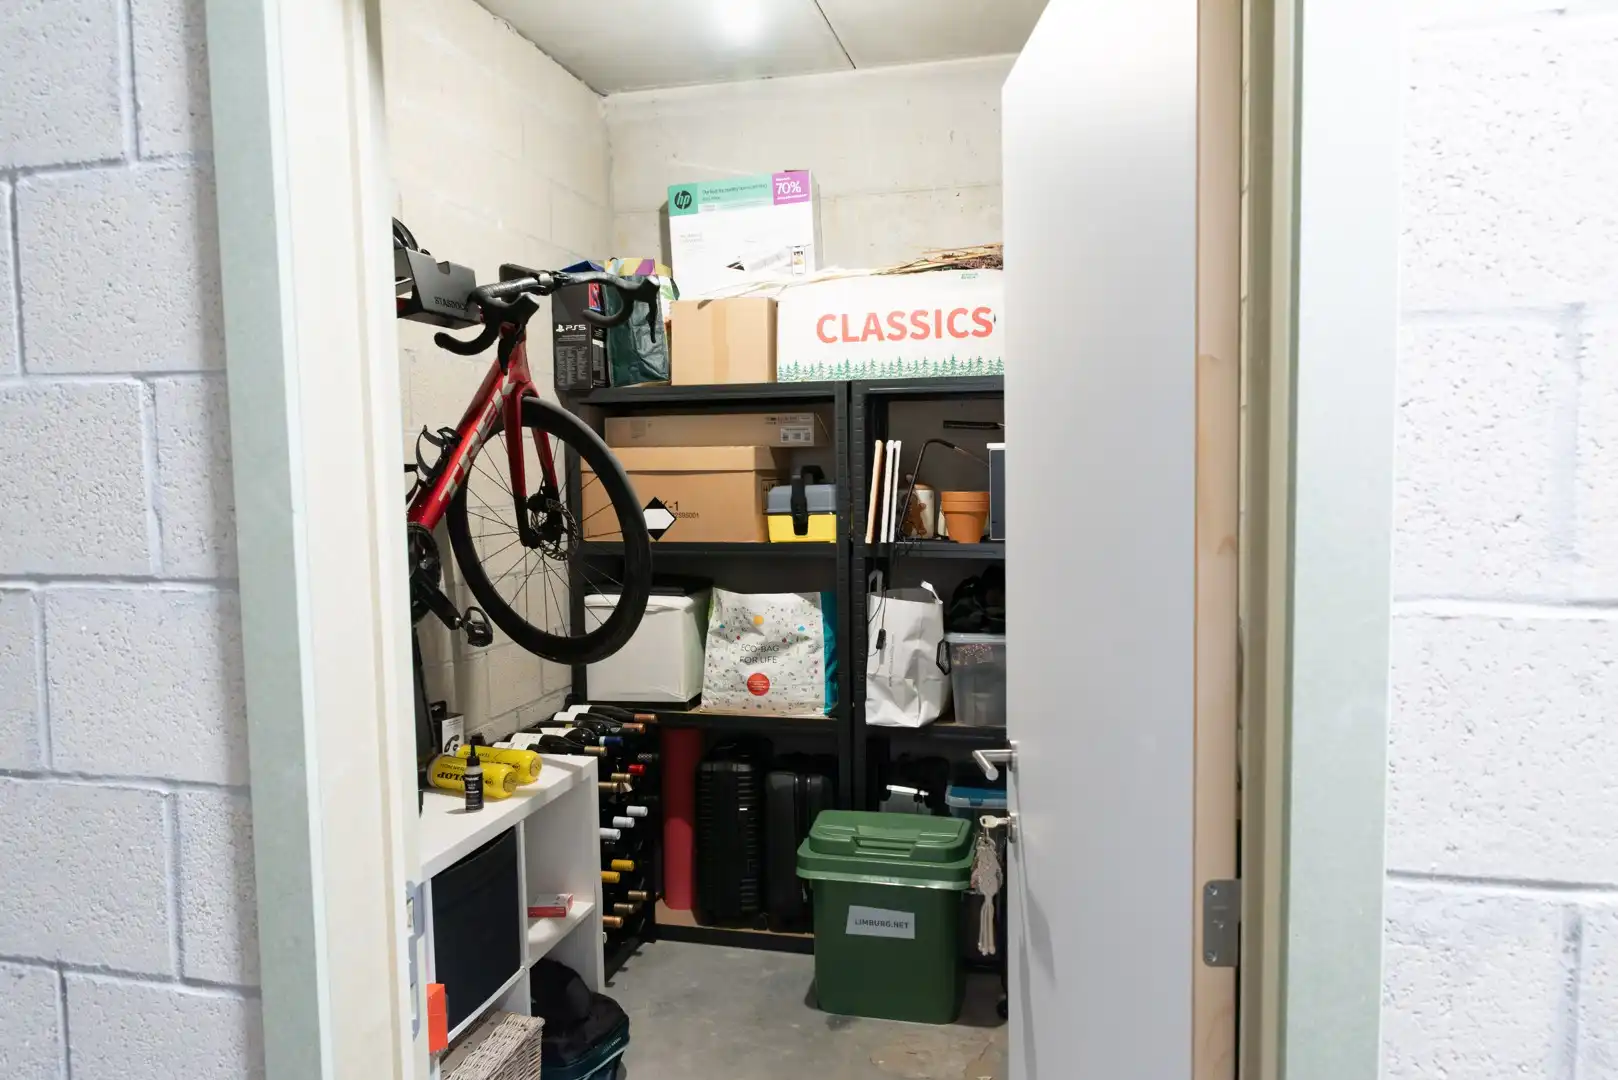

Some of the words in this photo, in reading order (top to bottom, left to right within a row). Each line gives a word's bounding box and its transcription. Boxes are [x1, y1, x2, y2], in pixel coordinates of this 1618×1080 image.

[776, 181, 802, 196] 70%
[675, 190, 693, 210] hp
[816, 306, 994, 344] CLASSICS
[740, 643, 780, 653] ECO-BAG
[739, 655, 758, 665] FOR
[760, 655, 778, 664] LIFE
[854, 918, 909, 929] LIMBURG.NET
